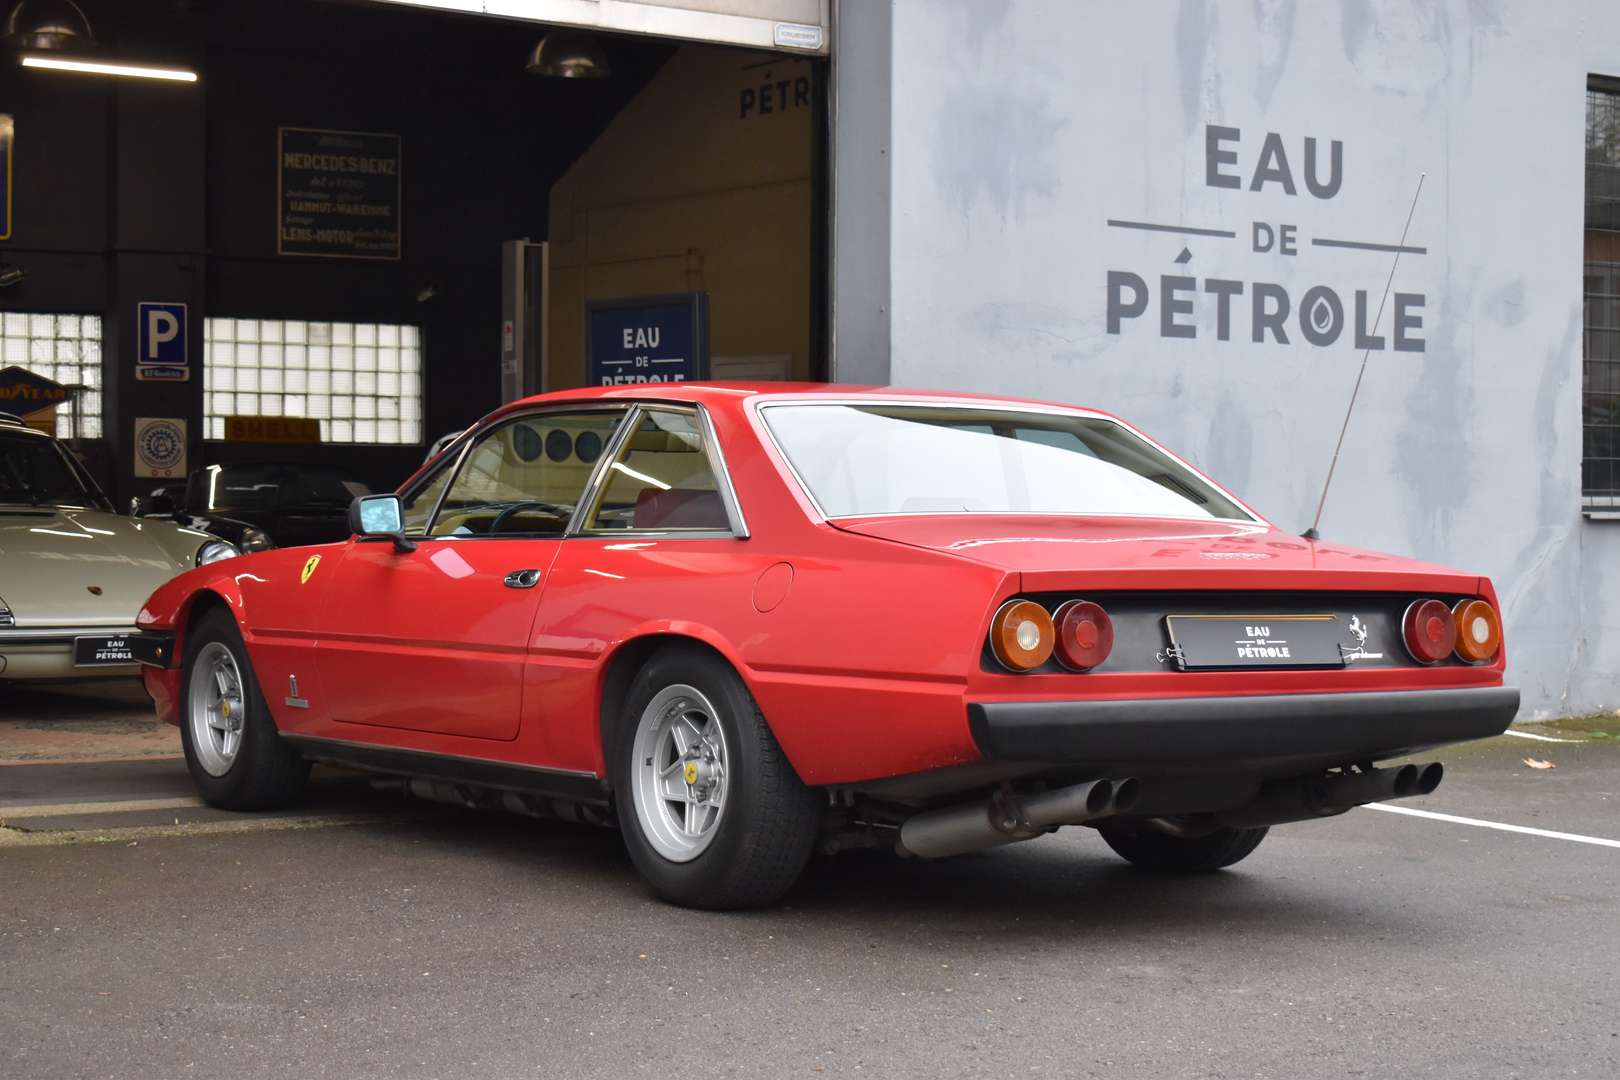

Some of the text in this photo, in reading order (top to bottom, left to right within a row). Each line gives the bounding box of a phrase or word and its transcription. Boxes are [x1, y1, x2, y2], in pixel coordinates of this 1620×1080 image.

[741, 71, 816, 118] PÉTR
[1206, 124, 1343, 200] EAU
[1252, 221, 1297, 256] DE
[1106, 246, 1426, 352] PÉTROLE
[148, 310, 180, 359] P
[623, 327, 660, 349] EAU
[635, 356, 649, 368] DE
[231, 419, 315, 440] SHELL
[1246, 626, 1270, 637] EAU
[96, 650, 132, 660] PÉTROLE
[1237, 644, 1291, 658] PÉTROLE
